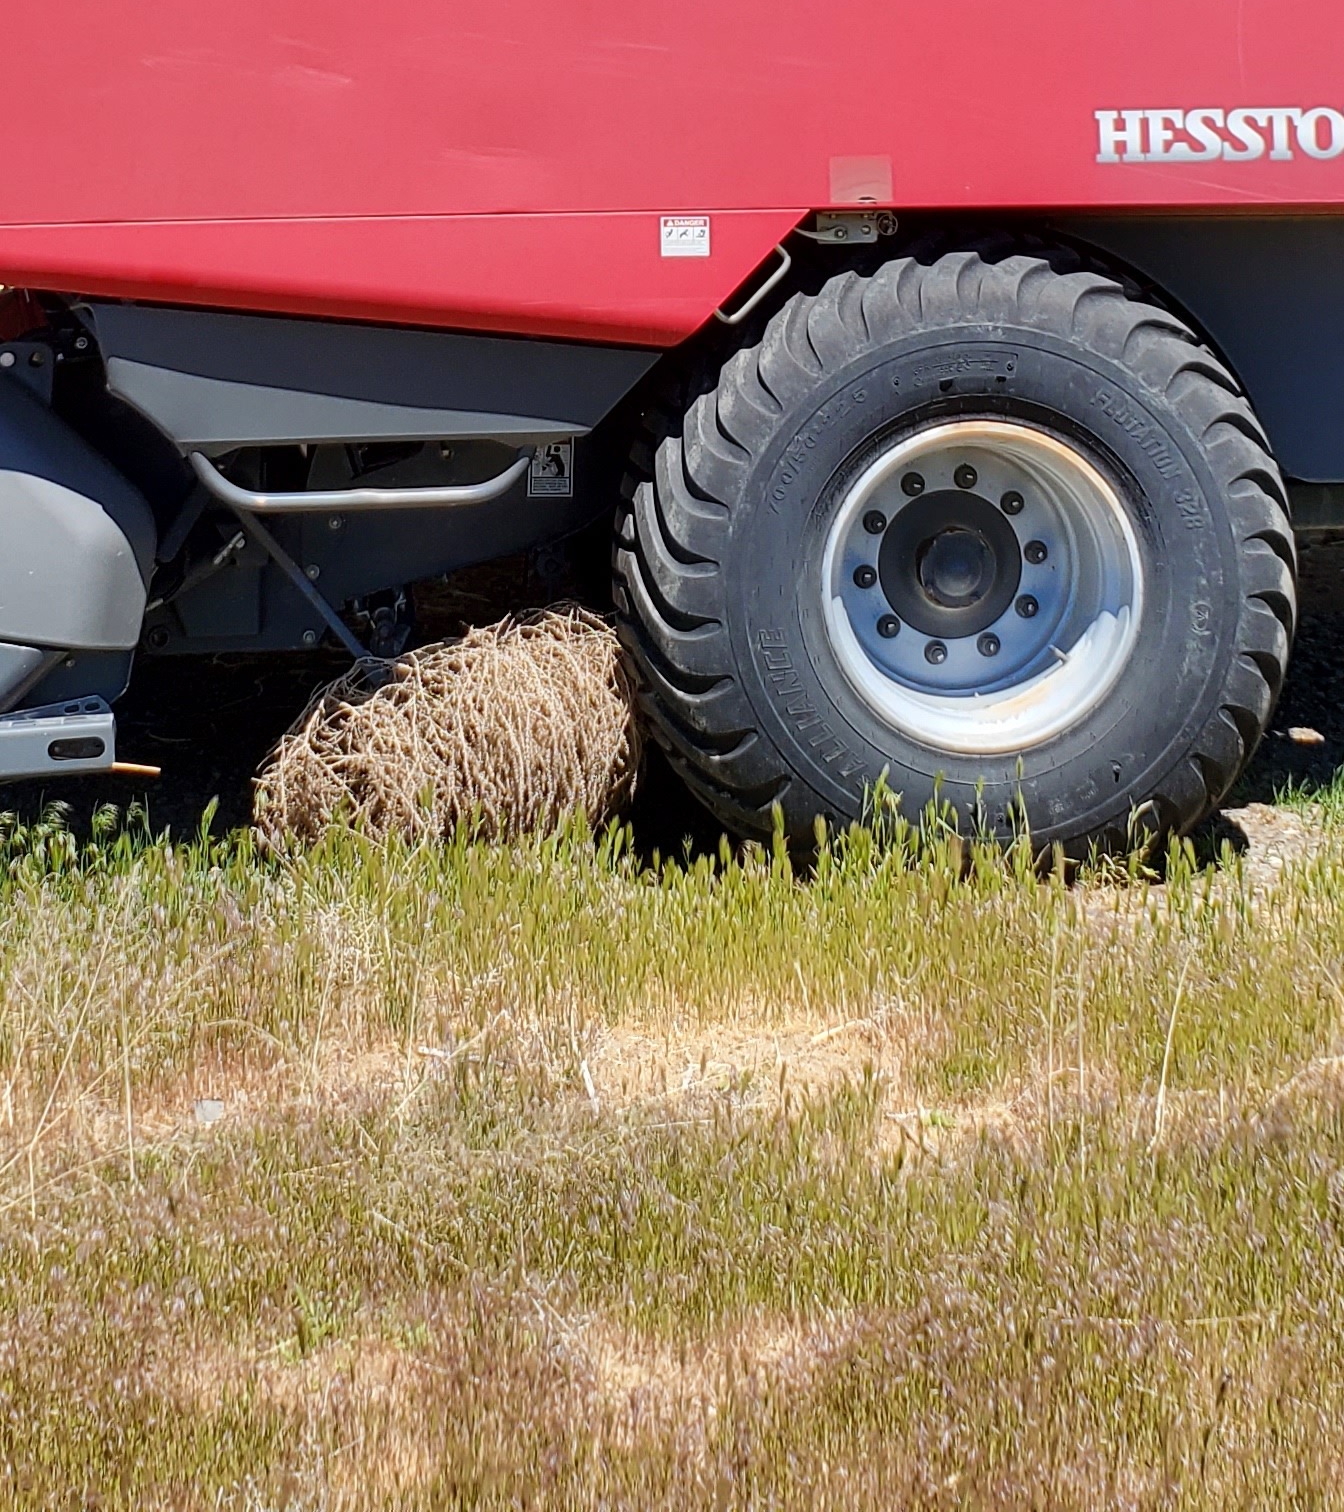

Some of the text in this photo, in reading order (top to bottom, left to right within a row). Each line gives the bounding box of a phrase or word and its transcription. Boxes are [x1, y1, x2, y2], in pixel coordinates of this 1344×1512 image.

[674, 219, 705, 227] DANGER
[1090, 389, 1205, 530] FLOTATION 328
[758, 626, 868, 778] ALLIANCE
